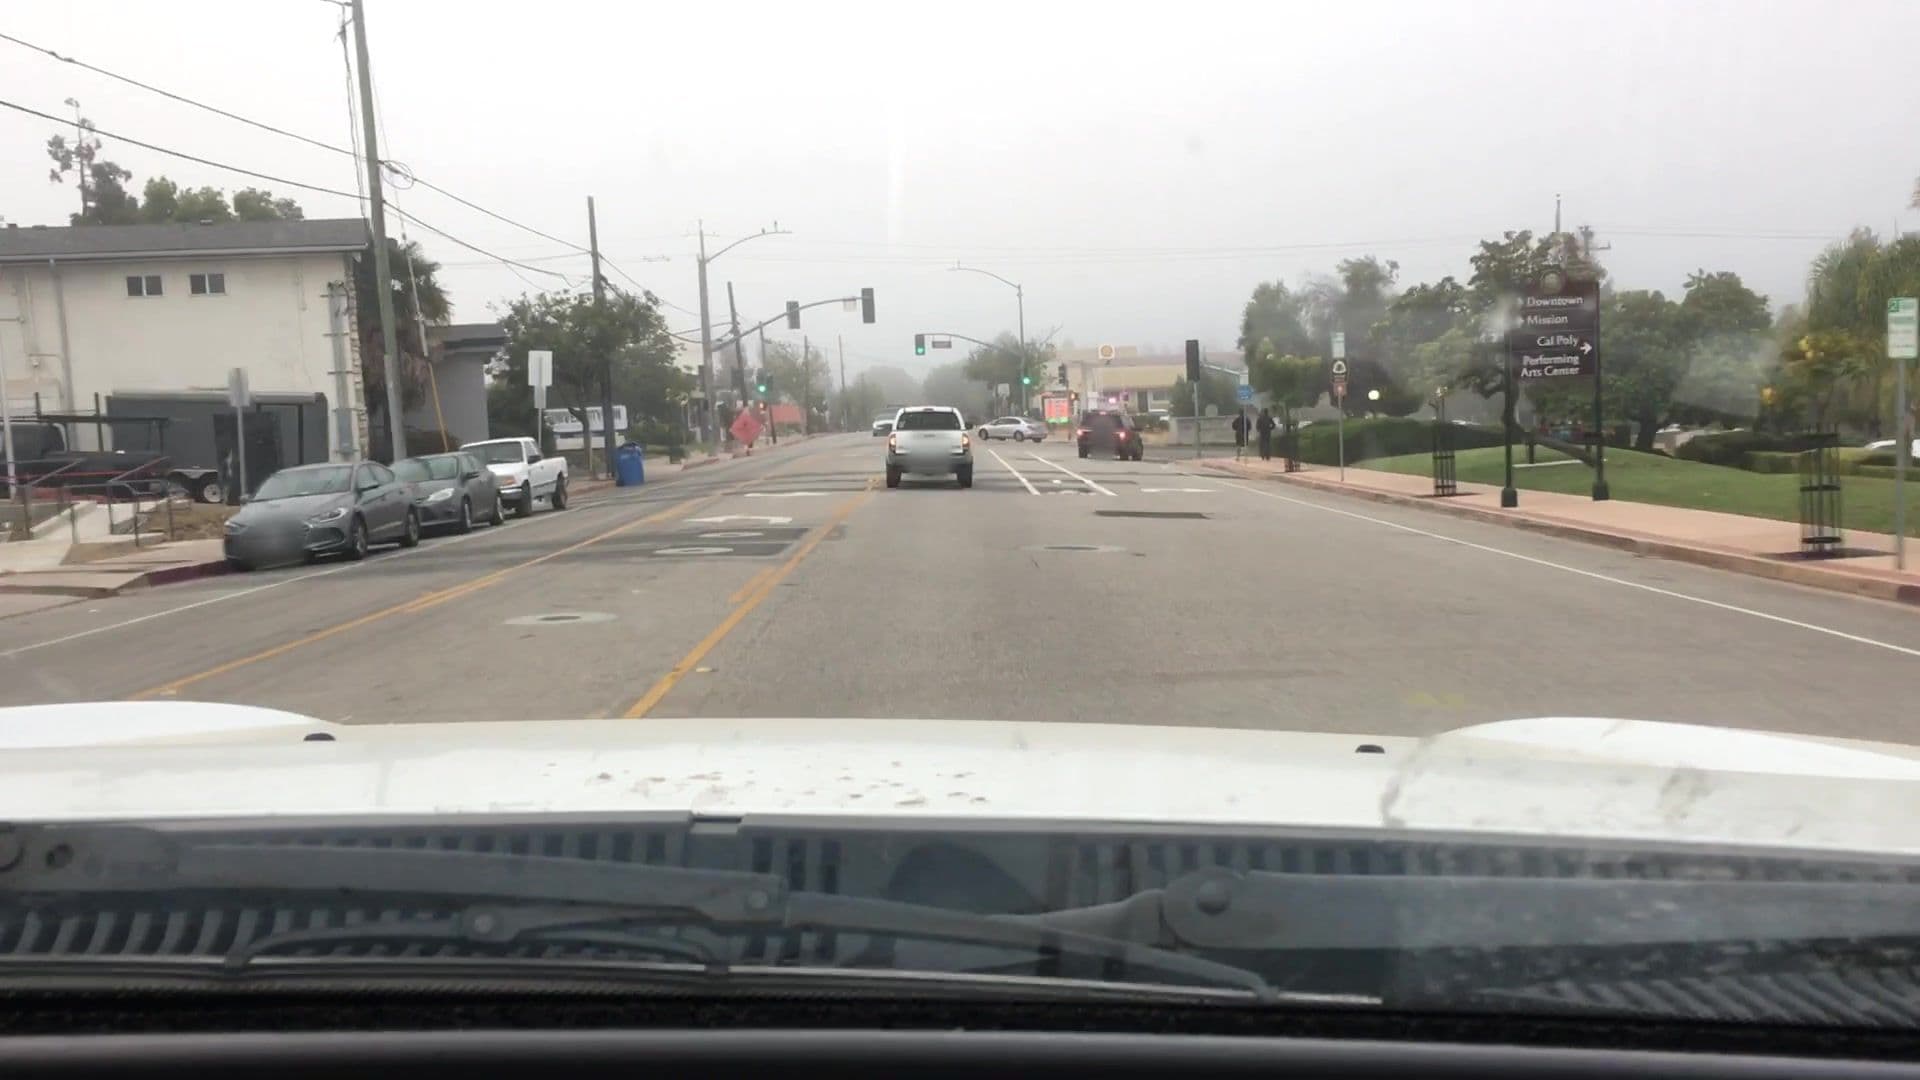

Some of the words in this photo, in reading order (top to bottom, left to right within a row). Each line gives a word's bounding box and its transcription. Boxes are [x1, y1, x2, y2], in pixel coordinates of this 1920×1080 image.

[1527, 296, 1583, 306] Downtown
[1527, 315, 1568, 325] Mission
[1537, 336, 1554, 347] Cal
[1556, 335, 1579, 347] Poly
[1522, 354, 1580, 365] Performing
[1520, 367, 1542, 377] Arts
[1544, 366, 1580, 376] Center
